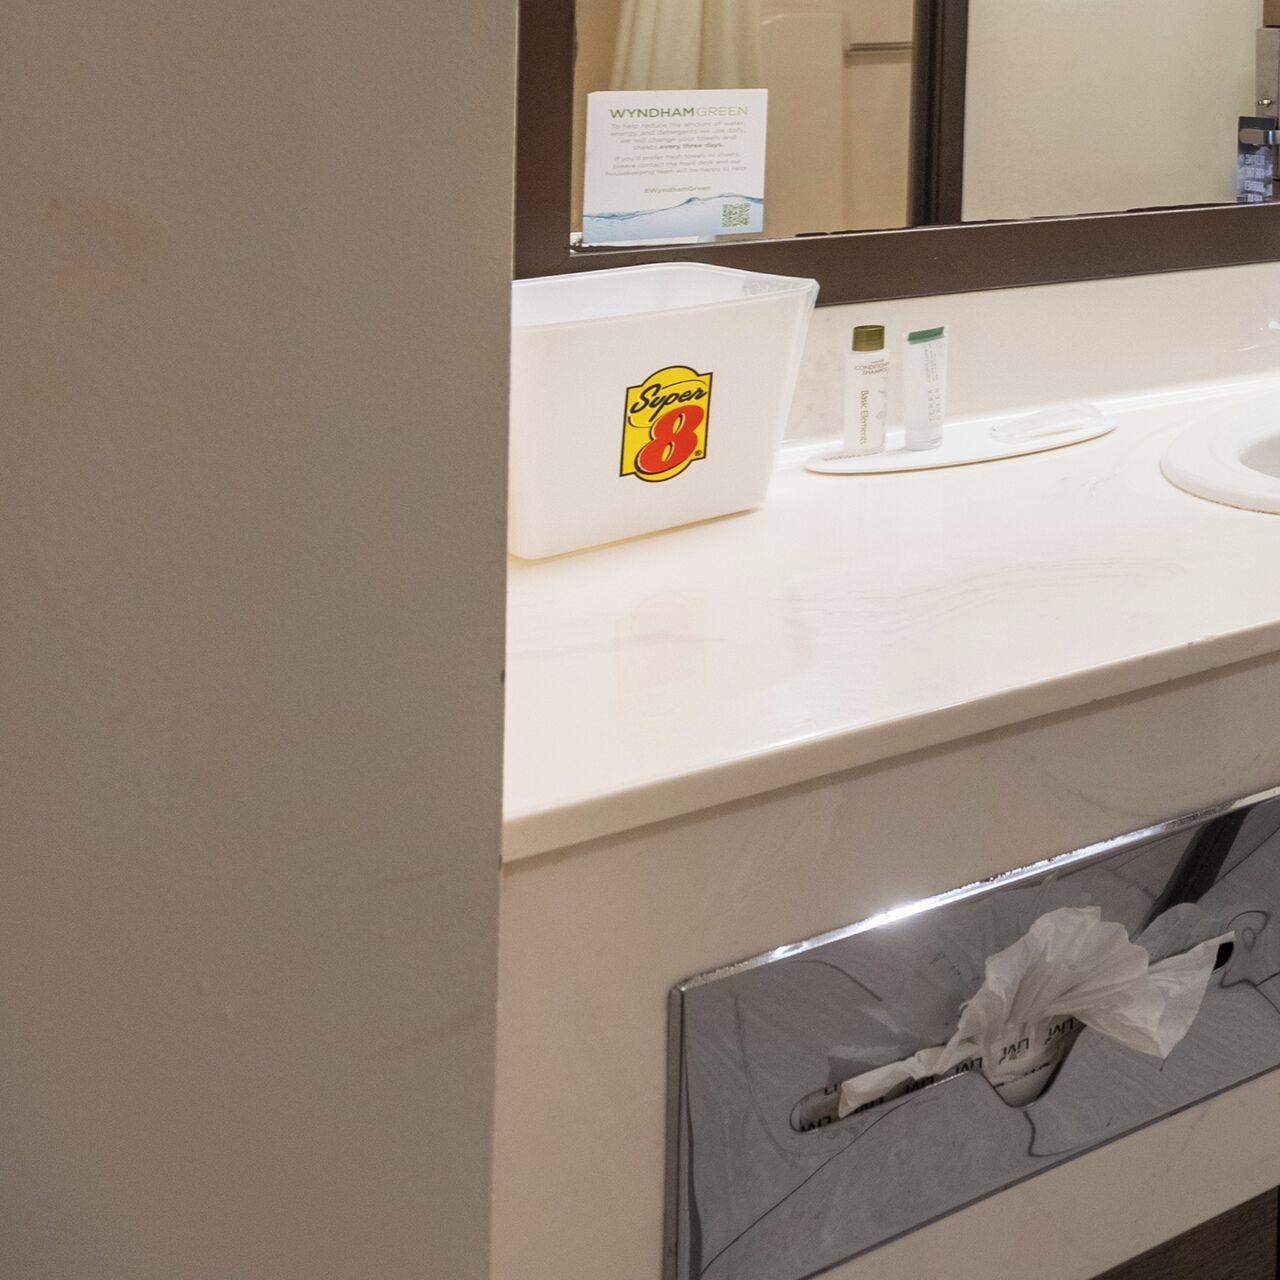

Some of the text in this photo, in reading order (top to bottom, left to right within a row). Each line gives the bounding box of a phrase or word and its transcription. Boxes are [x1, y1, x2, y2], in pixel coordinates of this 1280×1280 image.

[630, 384, 707, 422] Super
[859, 389, 870, 445] Basic Elements
[634, 404, 705, 475] 8
